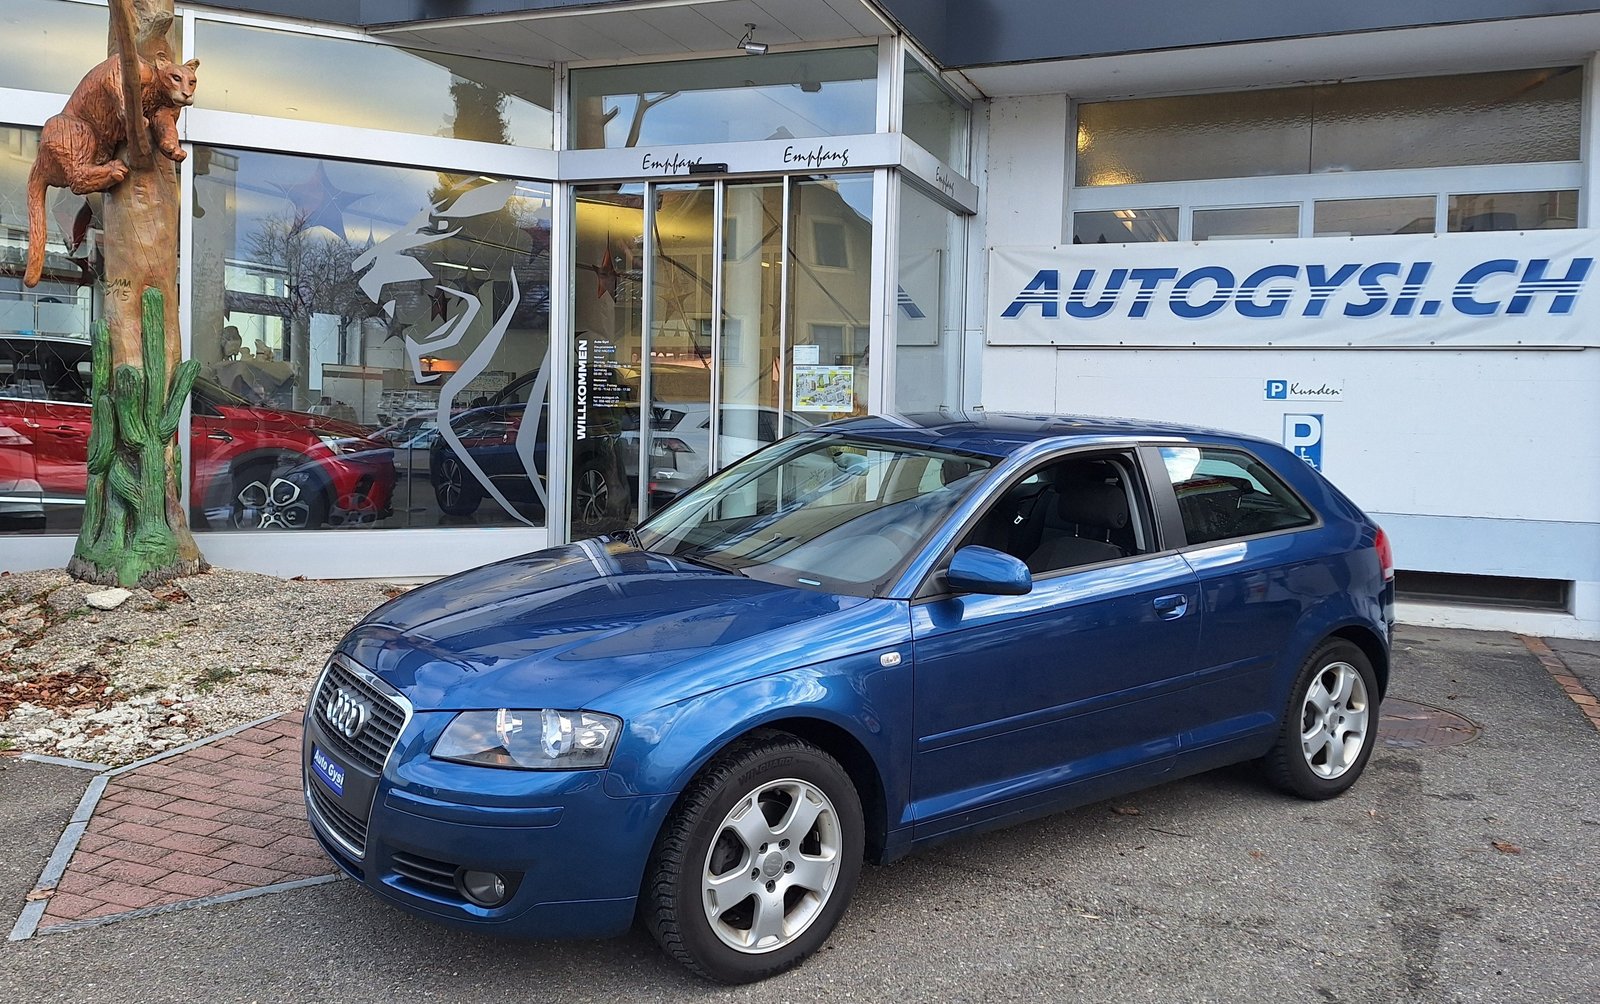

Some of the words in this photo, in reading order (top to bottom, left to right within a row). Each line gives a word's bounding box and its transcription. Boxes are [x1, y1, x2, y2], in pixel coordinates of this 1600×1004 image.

[783, 145, 849, 167] Empfang
[1000, 257, 1595, 319] AUTOGYSI.CH
[576, 340, 588, 440] WILLKOMMEN
[1271, 383, 1284, 397] P
[1290, 382, 1340, 396] Kunden
[1285, 415, 1321, 454] P
[313, 749, 328, 771] Auto
[328, 764, 345, 786] Gysi
